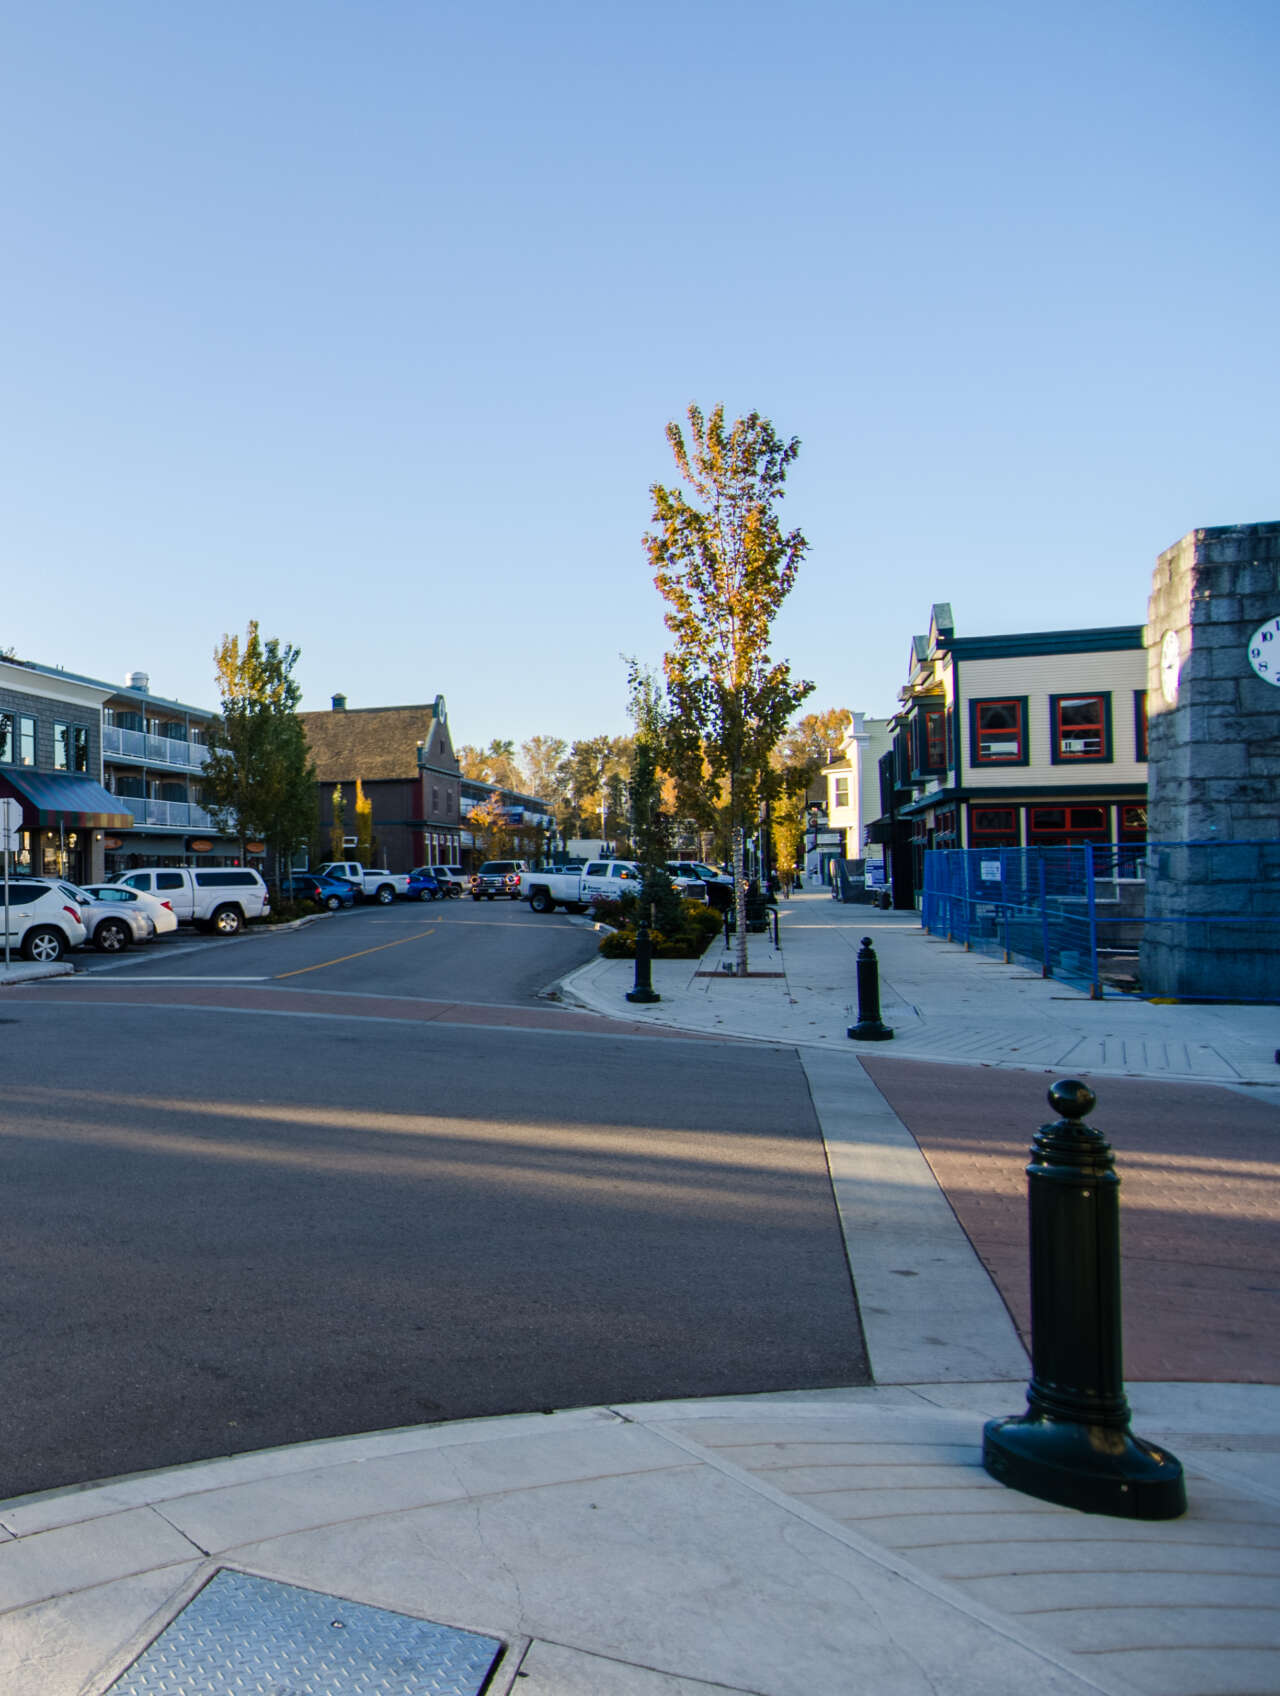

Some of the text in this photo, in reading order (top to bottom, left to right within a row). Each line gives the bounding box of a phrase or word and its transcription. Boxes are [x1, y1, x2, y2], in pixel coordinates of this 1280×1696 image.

[1261, 631, 1273, 643] 10
[1251, 647, 1261, 659] 9
[1258, 661, 1268, 672] 8
